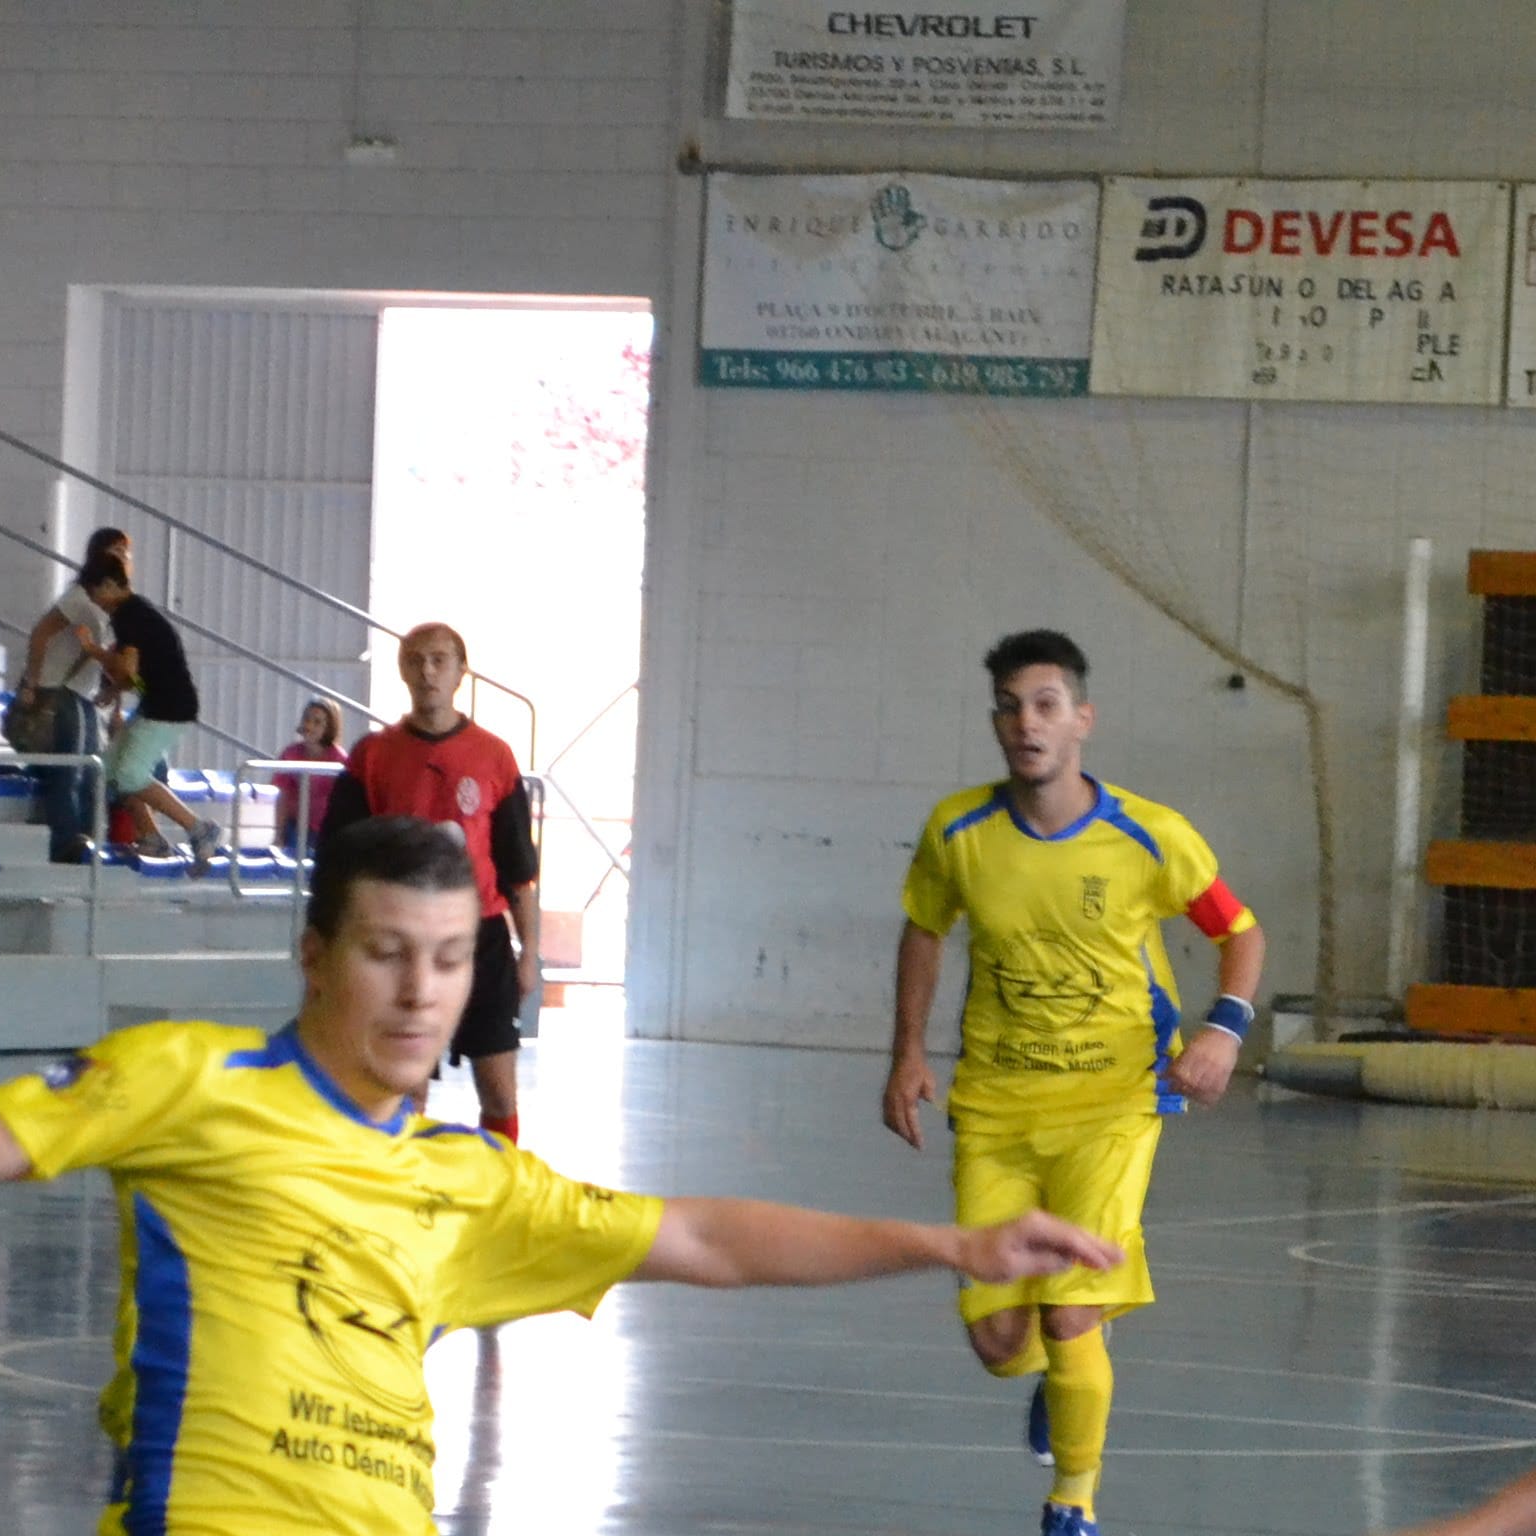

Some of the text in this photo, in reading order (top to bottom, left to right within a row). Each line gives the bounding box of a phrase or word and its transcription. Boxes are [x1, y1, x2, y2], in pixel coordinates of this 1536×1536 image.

[827, 12, 1038, 39] CHEVROLET
[773, 51, 885, 72] TURISMOS
[891, 55, 904, 72] Y
[1222, 209, 1461, 258] DEVESA
[1338, 277, 1377, 301] DEL
[289, 1388, 335, 1426] Wir
[271, 1427, 335, 1465] Auto
